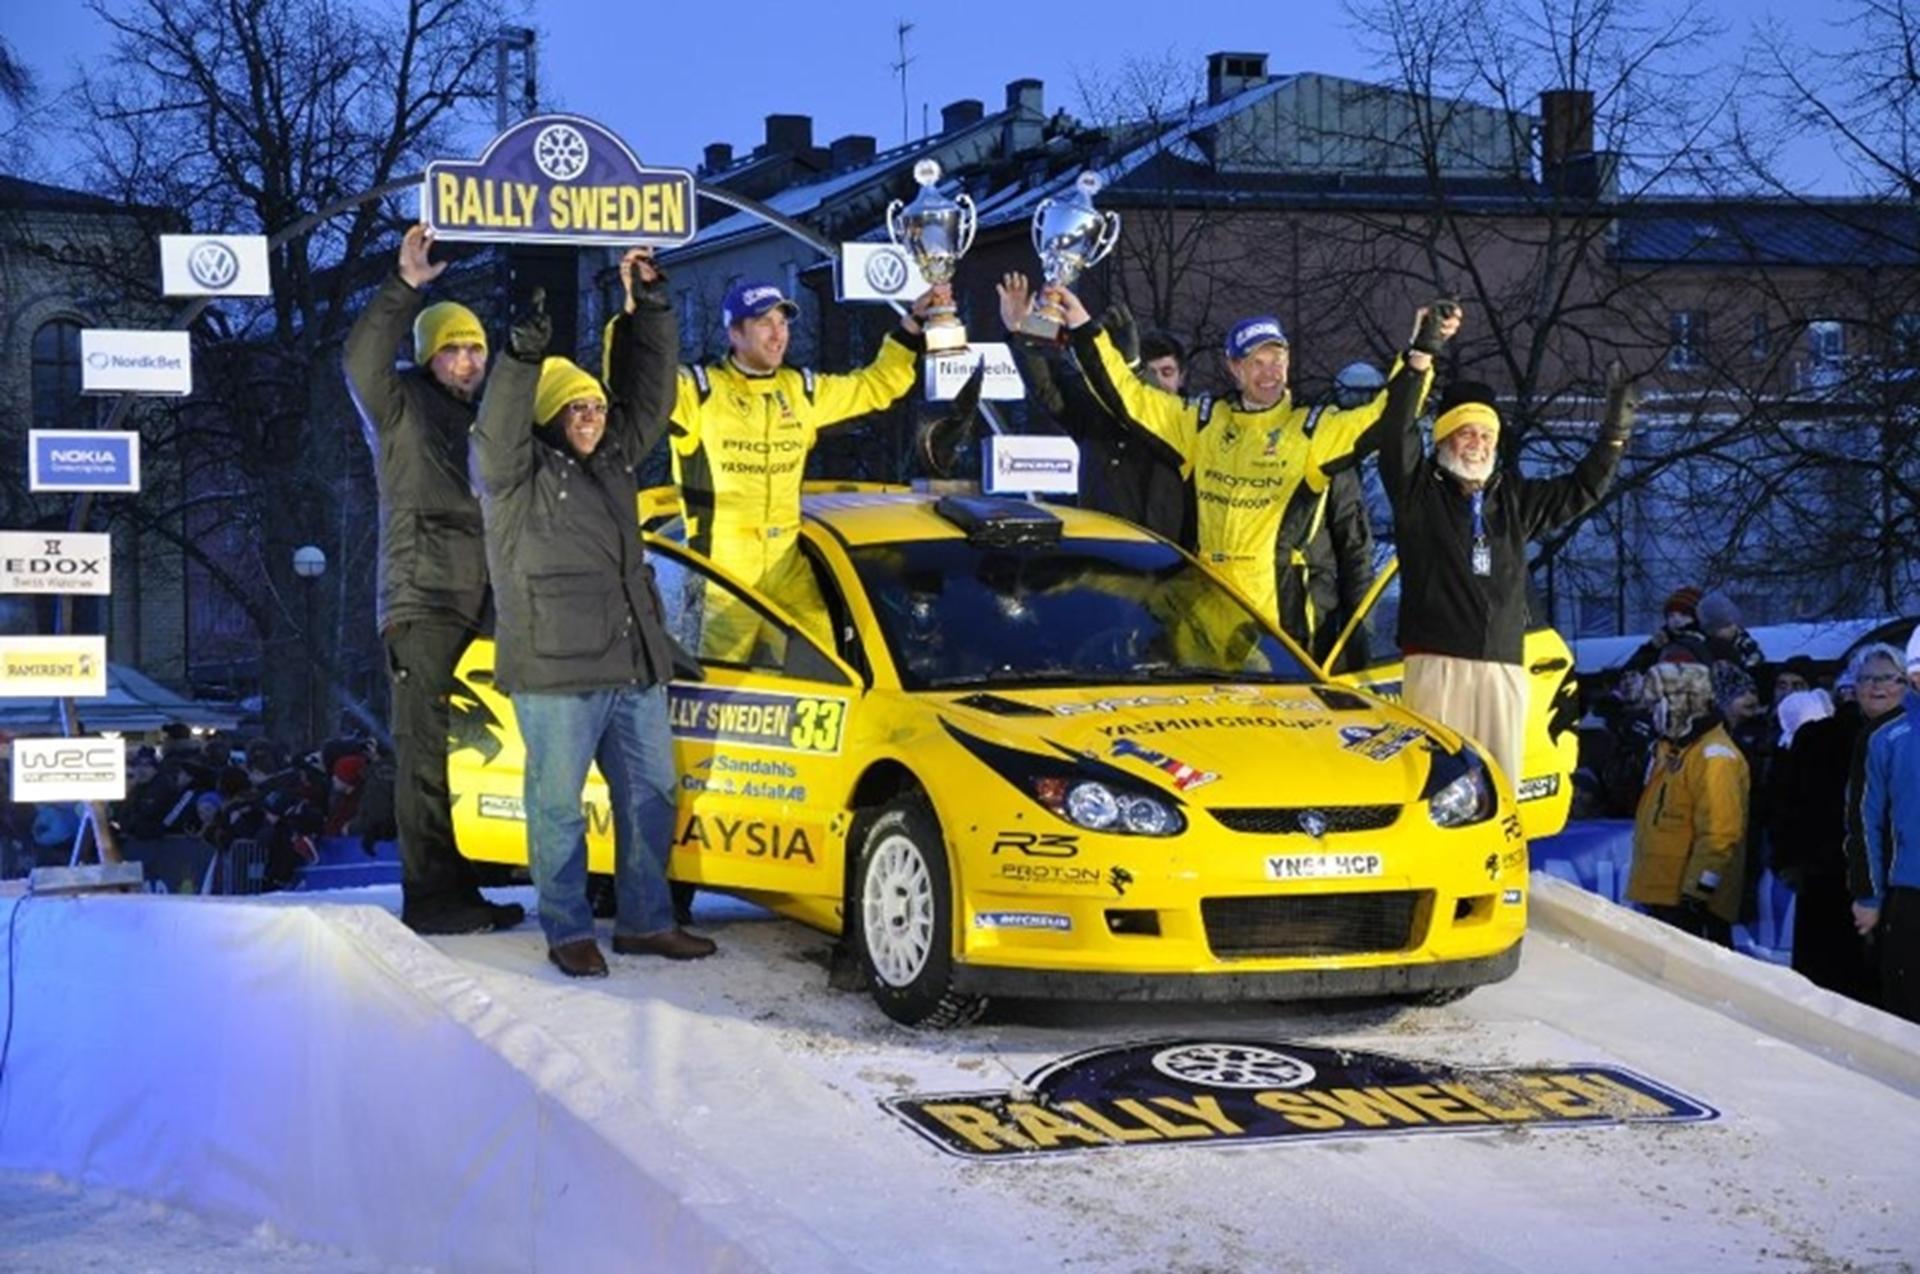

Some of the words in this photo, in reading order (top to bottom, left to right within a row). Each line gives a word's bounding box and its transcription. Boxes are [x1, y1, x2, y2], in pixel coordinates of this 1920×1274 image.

[437, 172, 539, 227] RALLY
[549, 181, 685, 233] SWEDEN
[111, 354, 182, 370] NordicBet
[51, 449, 117, 463] NOKIA
[722, 440, 802, 454] PROTON
[1205, 469, 1283, 489] PROTON
[6, 557, 100, 575] EDOX
[7, 662, 74, 677] RAMIRENT
[668, 696, 703, 729] LLY
[706, 703, 791, 738] SWEDEN
[790, 699, 842, 751] 33
[21, 748, 116, 769] WRC
[992, 831, 1080, 859] R3
[1001, 862, 1101, 880] PROTON
[921, 1094, 1247, 1152] RALLY
